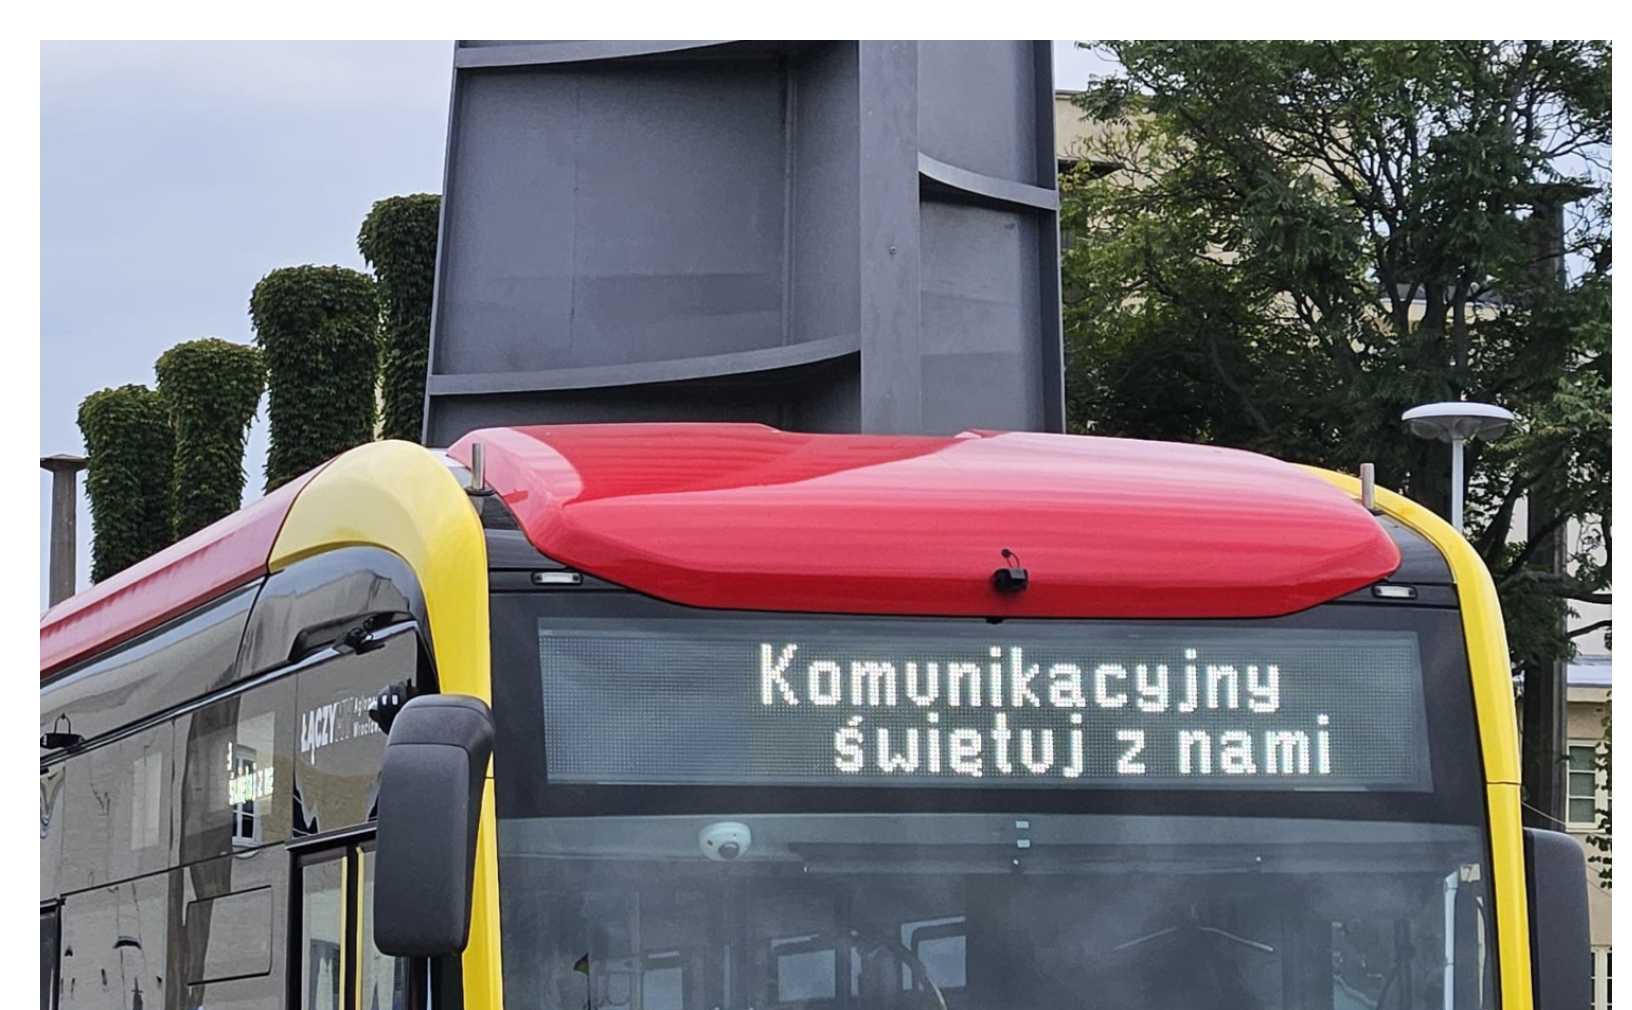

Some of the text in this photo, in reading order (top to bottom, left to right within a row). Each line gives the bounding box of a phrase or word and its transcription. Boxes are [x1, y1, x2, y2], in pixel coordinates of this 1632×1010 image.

[760, 642, 1282, 713] Komunikacyjny
[833, 713, 1333, 778] świętuj z nami
